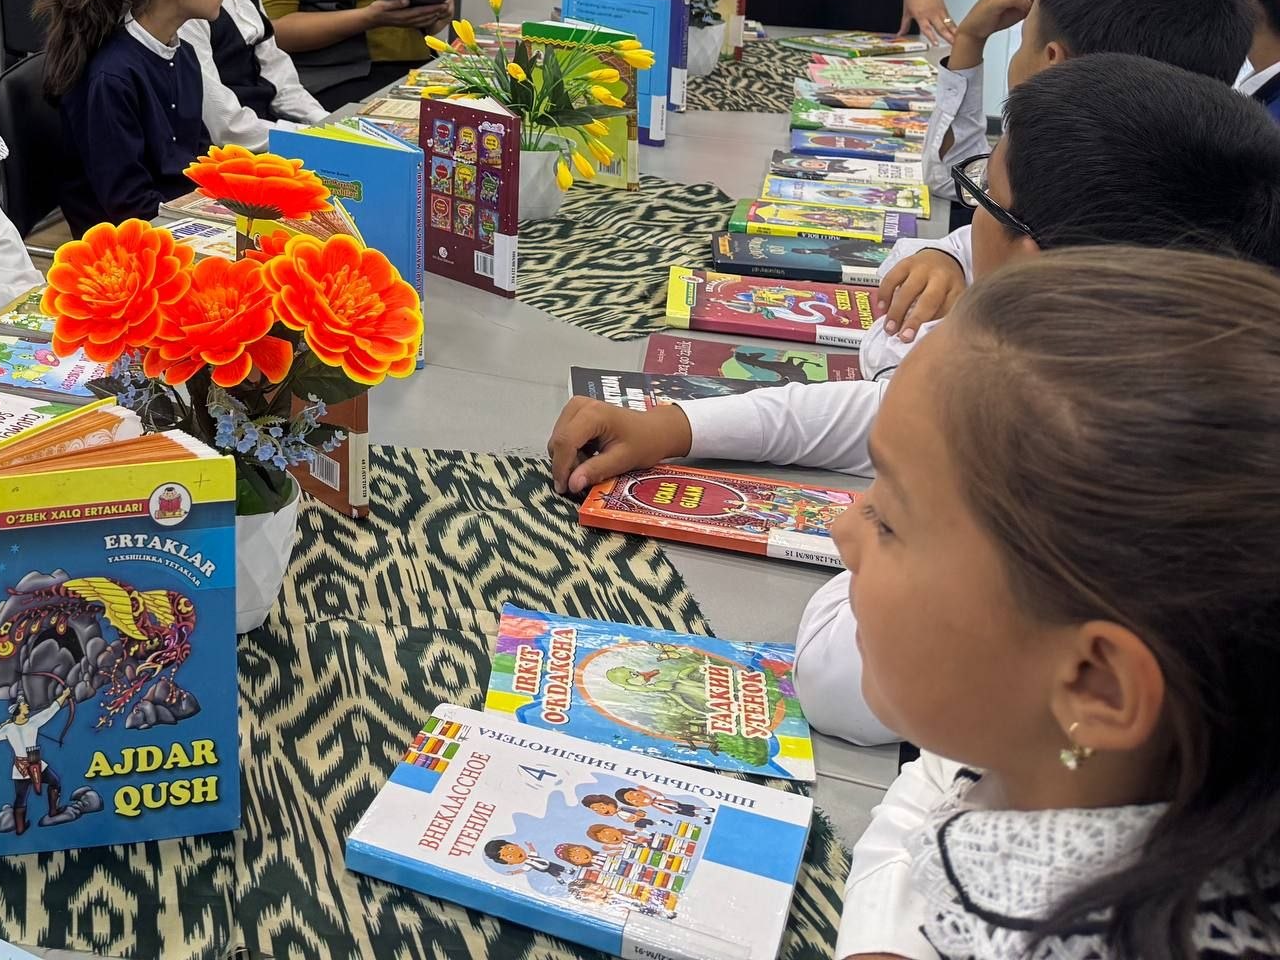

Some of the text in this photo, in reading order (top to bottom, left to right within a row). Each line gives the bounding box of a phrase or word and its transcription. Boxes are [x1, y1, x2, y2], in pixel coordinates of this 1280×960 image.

[5, 503, 144, 526] O'ZBEK XALQ ERTAKLARI
[679, 485, 707, 509] GILAM
[104, 534, 217, 579] ERTAKLAR
[516, 644, 543, 694] IRKIT
[542, 627, 576, 724] O'RDAKCHA
[708, 655, 731, 735] ГАДКИЙ
[735, 669, 766, 739] УТЁНОК
[84, 738, 219, 779] AJDAR
[477, 725, 756, 810] ШКОЛЬНАЯ БИБЛИОТЕКА
[519, 764, 557, 790] 4
[113, 775, 219, 817] QUSH
[418, 751, 492, 853] ВНЕКЛАССНОЕ
[447, 799, 497, 858] ЧТЕНИЕ
